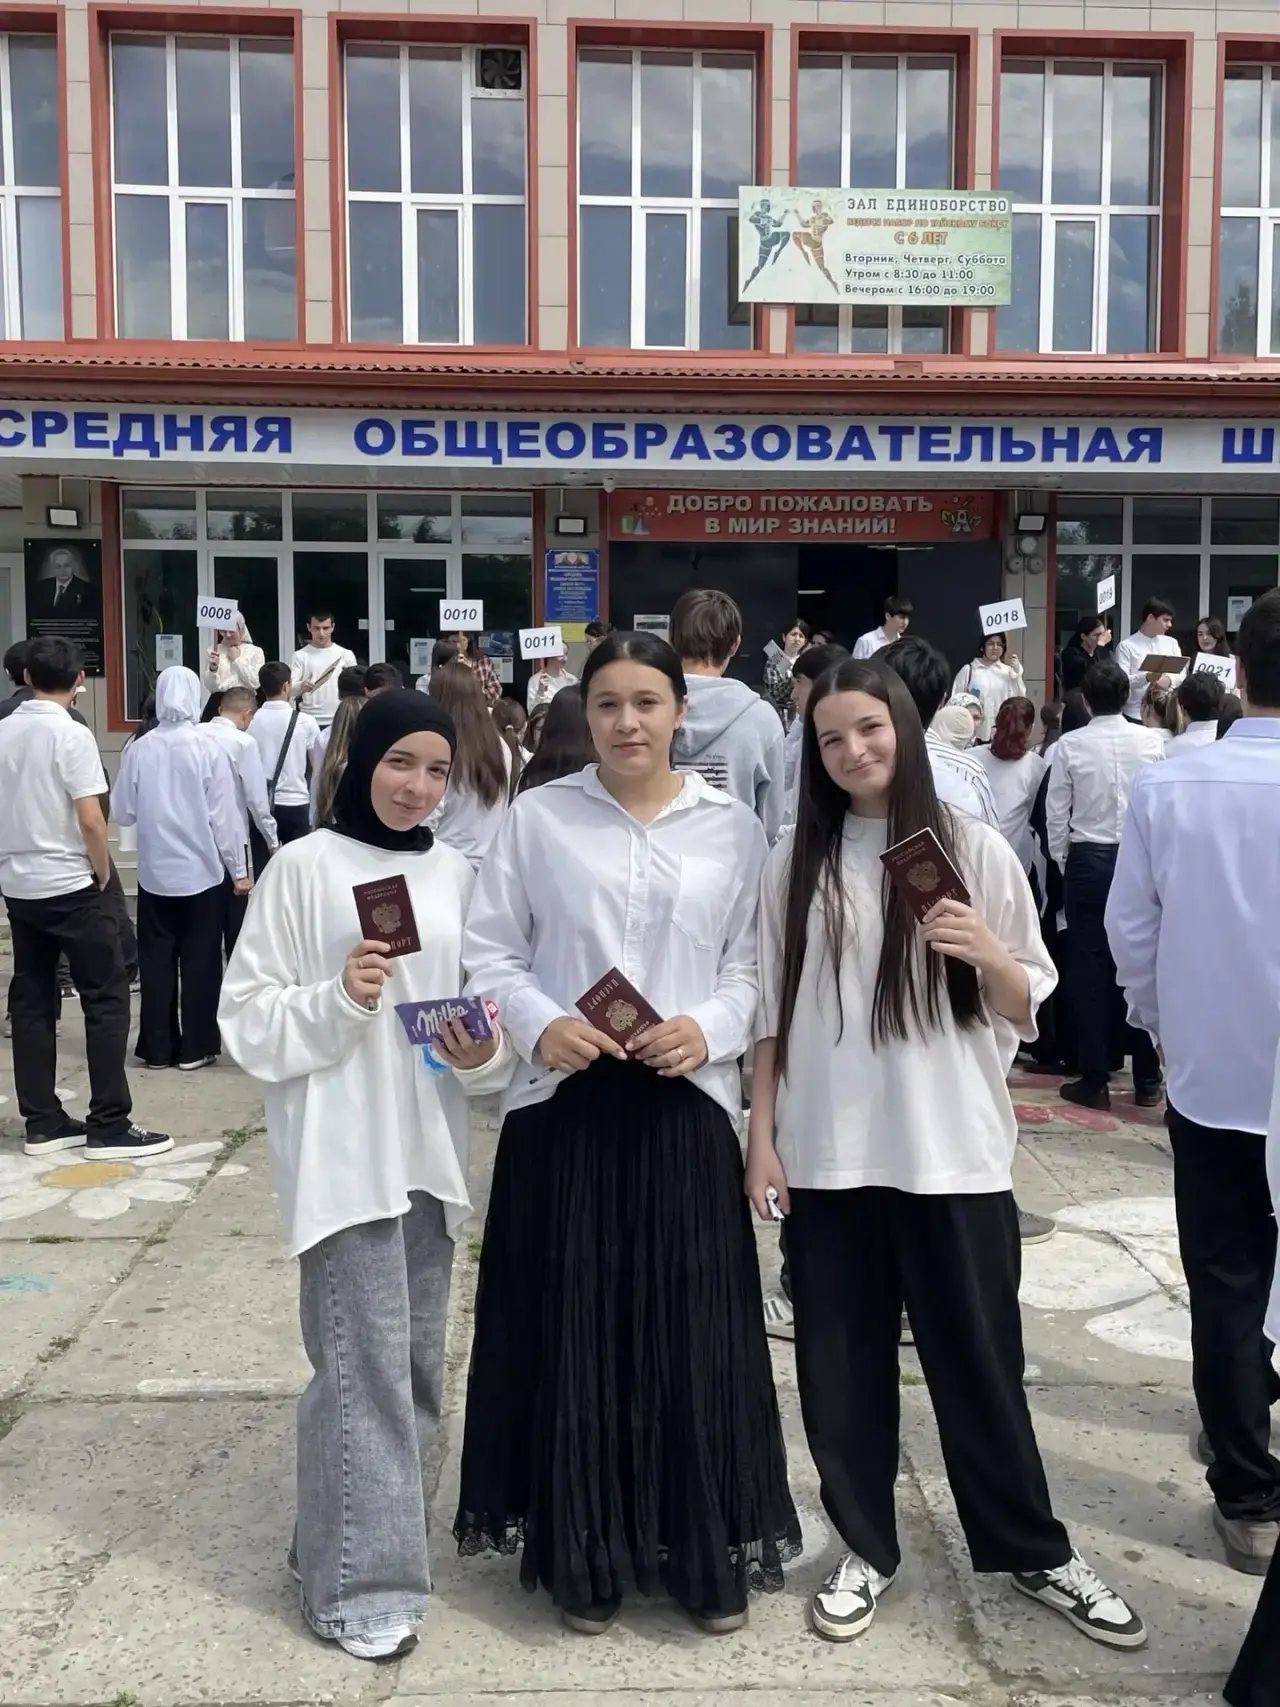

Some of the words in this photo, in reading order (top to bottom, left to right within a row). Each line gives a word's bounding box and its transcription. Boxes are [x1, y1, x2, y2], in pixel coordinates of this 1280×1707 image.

[848, 198, 877, 210] ЗАЛ
[887, 199, 1007, 212] ЕДИНОБОРСТВО
[894, 231, 904, 244] С
[908, 231, 918, 245] 6
[921, 232, 948, 245] ЛЕТ
[845, 253, 898, 265] Вторник,
[903, 254, 952, 266] Четверг,
[957, 254, 1006, 265] Суббота
[845, 269, 880, 280] Утром
[884, 271, 889, 279] с
[894, 269, 919, 279] 8:30
[923, 271, 936, 280] до
[942, 270, 973, 280] 11:00
[845, 285, 894, 296] Вечером
[898, 287, 903, 295] с
[908, 285, 940, 295] 16:00
[943, 287, 957, 296] до
[963, 285, 995, 296] 19:00
[0, 409, 292, 459] СРЕДНЯЯ
[353, 417, 1163, 465] ОБЩЕОБРАЗОВАТЕЛЬНАЯ
[1222, 427, 1280, 463] Ш
[667, 495, 752, 515] ДОБРО
[760, 496, 934, 513] ПОЖАЛОВАТЬ
[704, 518, 721, 534] В
[729, 518, 781, 535] МИР
[788, 515, 896, 535] ЗНАНИЙ!
[200, 605, 232, 621] 0008
[443, 608, 477, 621] 0010
[985, 610, 1019, 628] 0018
[524, 635, 556, 650] 0011
[1197, 663, 1232, 678] 0021
[390, 936, 412, 950] ПОРТ
[586, 978, 620, 1011] ПАСПОРТ
[417, 1001, 469, 1037] Milka
